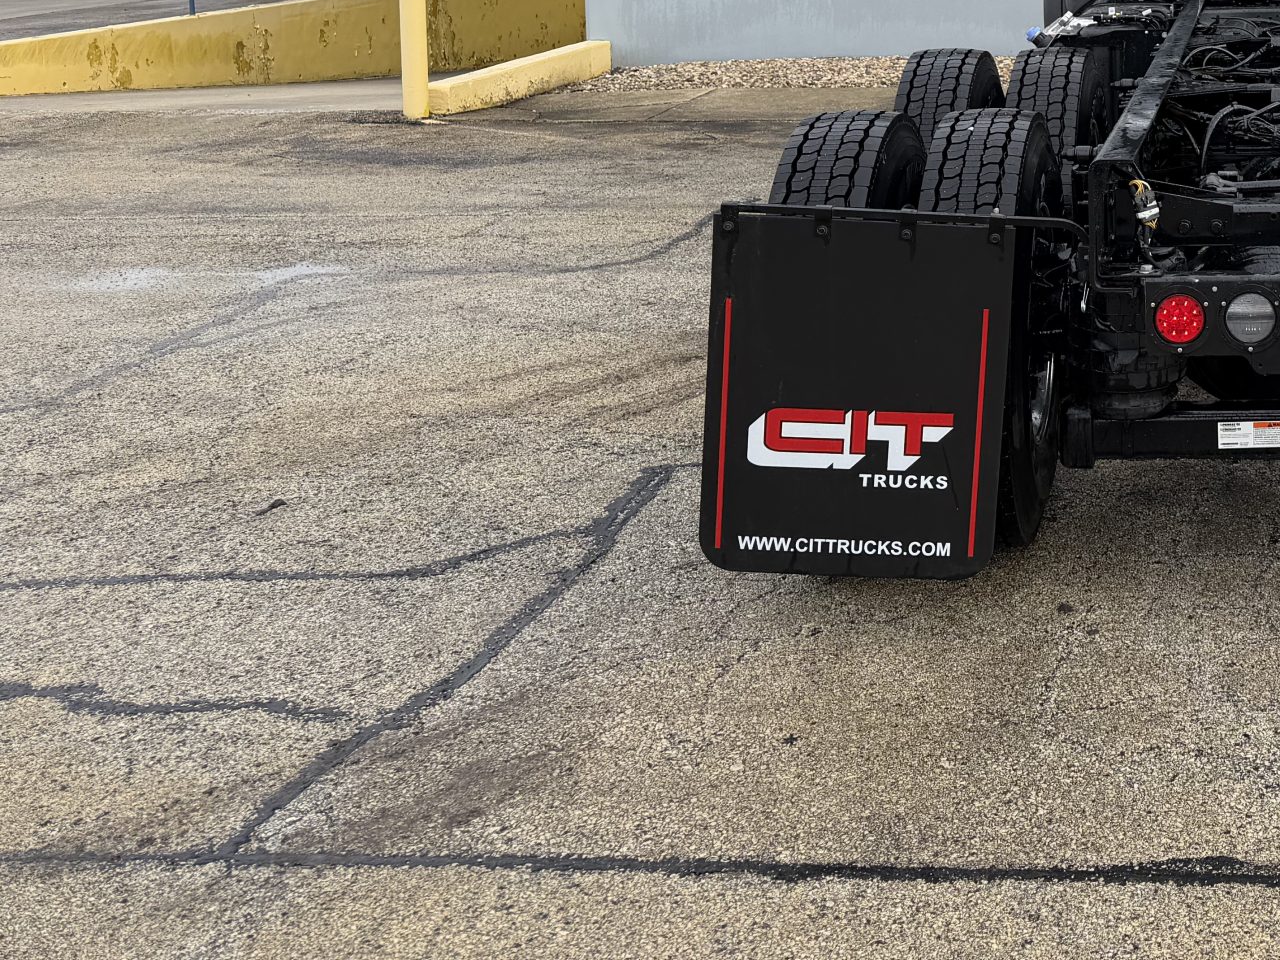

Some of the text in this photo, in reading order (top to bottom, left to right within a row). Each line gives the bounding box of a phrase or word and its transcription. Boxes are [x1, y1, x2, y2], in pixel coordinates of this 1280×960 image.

[747, 408, 954, 471] CIT
[858, 473, 949, 490] TRUCKS
[737, 535, 951, 558] WWW.CITTRUCKS.COM
